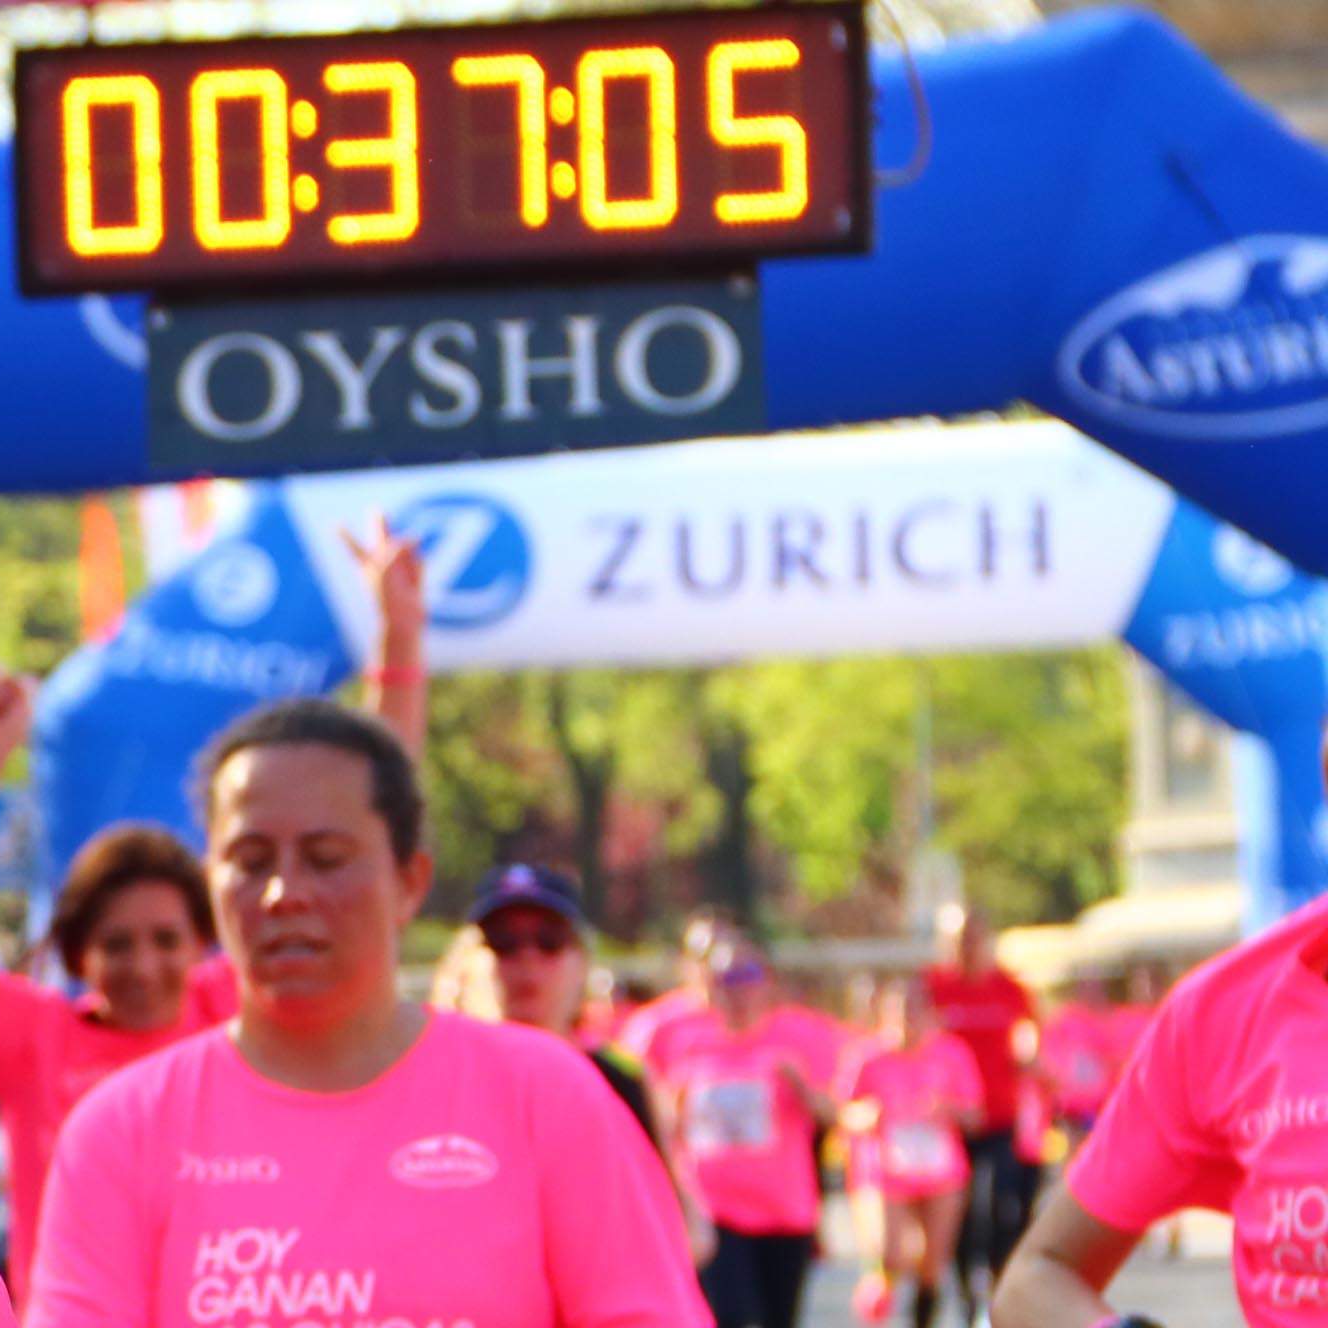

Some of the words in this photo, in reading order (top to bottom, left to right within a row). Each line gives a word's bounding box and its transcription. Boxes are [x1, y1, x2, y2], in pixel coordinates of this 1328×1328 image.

[61, 37, 809, 257] 00:37:05
[176, 303, 743, 443] OYSHO
[584, 496, 1052, 602] ZURICH
[188, 1269, 375, 1324] GANAN
[194, 1226, 301, 1276] HOY
